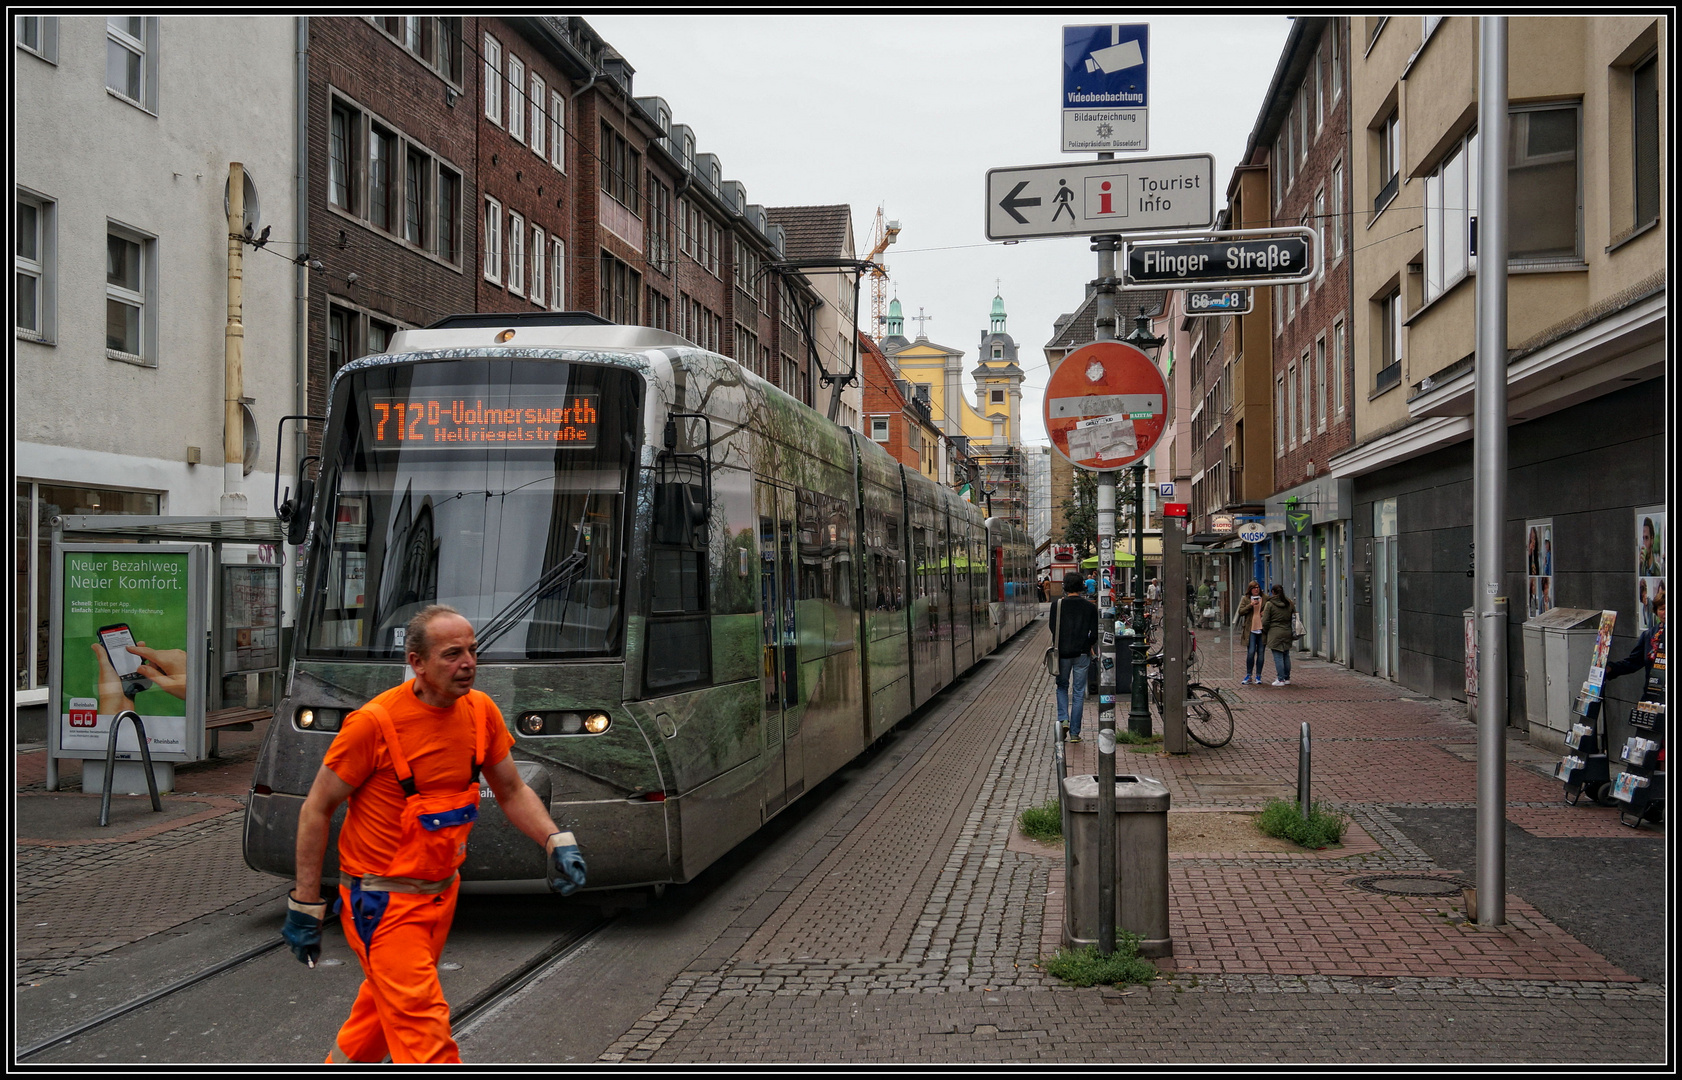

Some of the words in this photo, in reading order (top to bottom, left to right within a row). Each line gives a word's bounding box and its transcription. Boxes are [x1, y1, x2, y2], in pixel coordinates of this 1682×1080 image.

[1067, 91, 1143, 103] Videobeobachtung
[1074, 112, 1136, 122] Bildaufzeichnung
[1068, 140, 1111, 148] Polizeipräsidium
[1112, 139, 1141, 147] Düsseldorf
[1139, 175, 1200, 192] Tourist
[1139, 197, 1172, 212] Info
[1144, 250, 1208, 277] Flinger
[1226, 244, 1291, 272] Straße
[374, 403, 424, 441] 712
[434, 426, 587, 442] Hellriegelstraße
[1241, 531, 1265, 542] KIOSK
[71, 559, 108, 571] Neuer
[112, 559, 182, 575] Bezahlweg.
[71, 575, 113, 589] Neuer
[119, 575, 182, 590] Komfort.
[396, 630, 404, 638] 10
